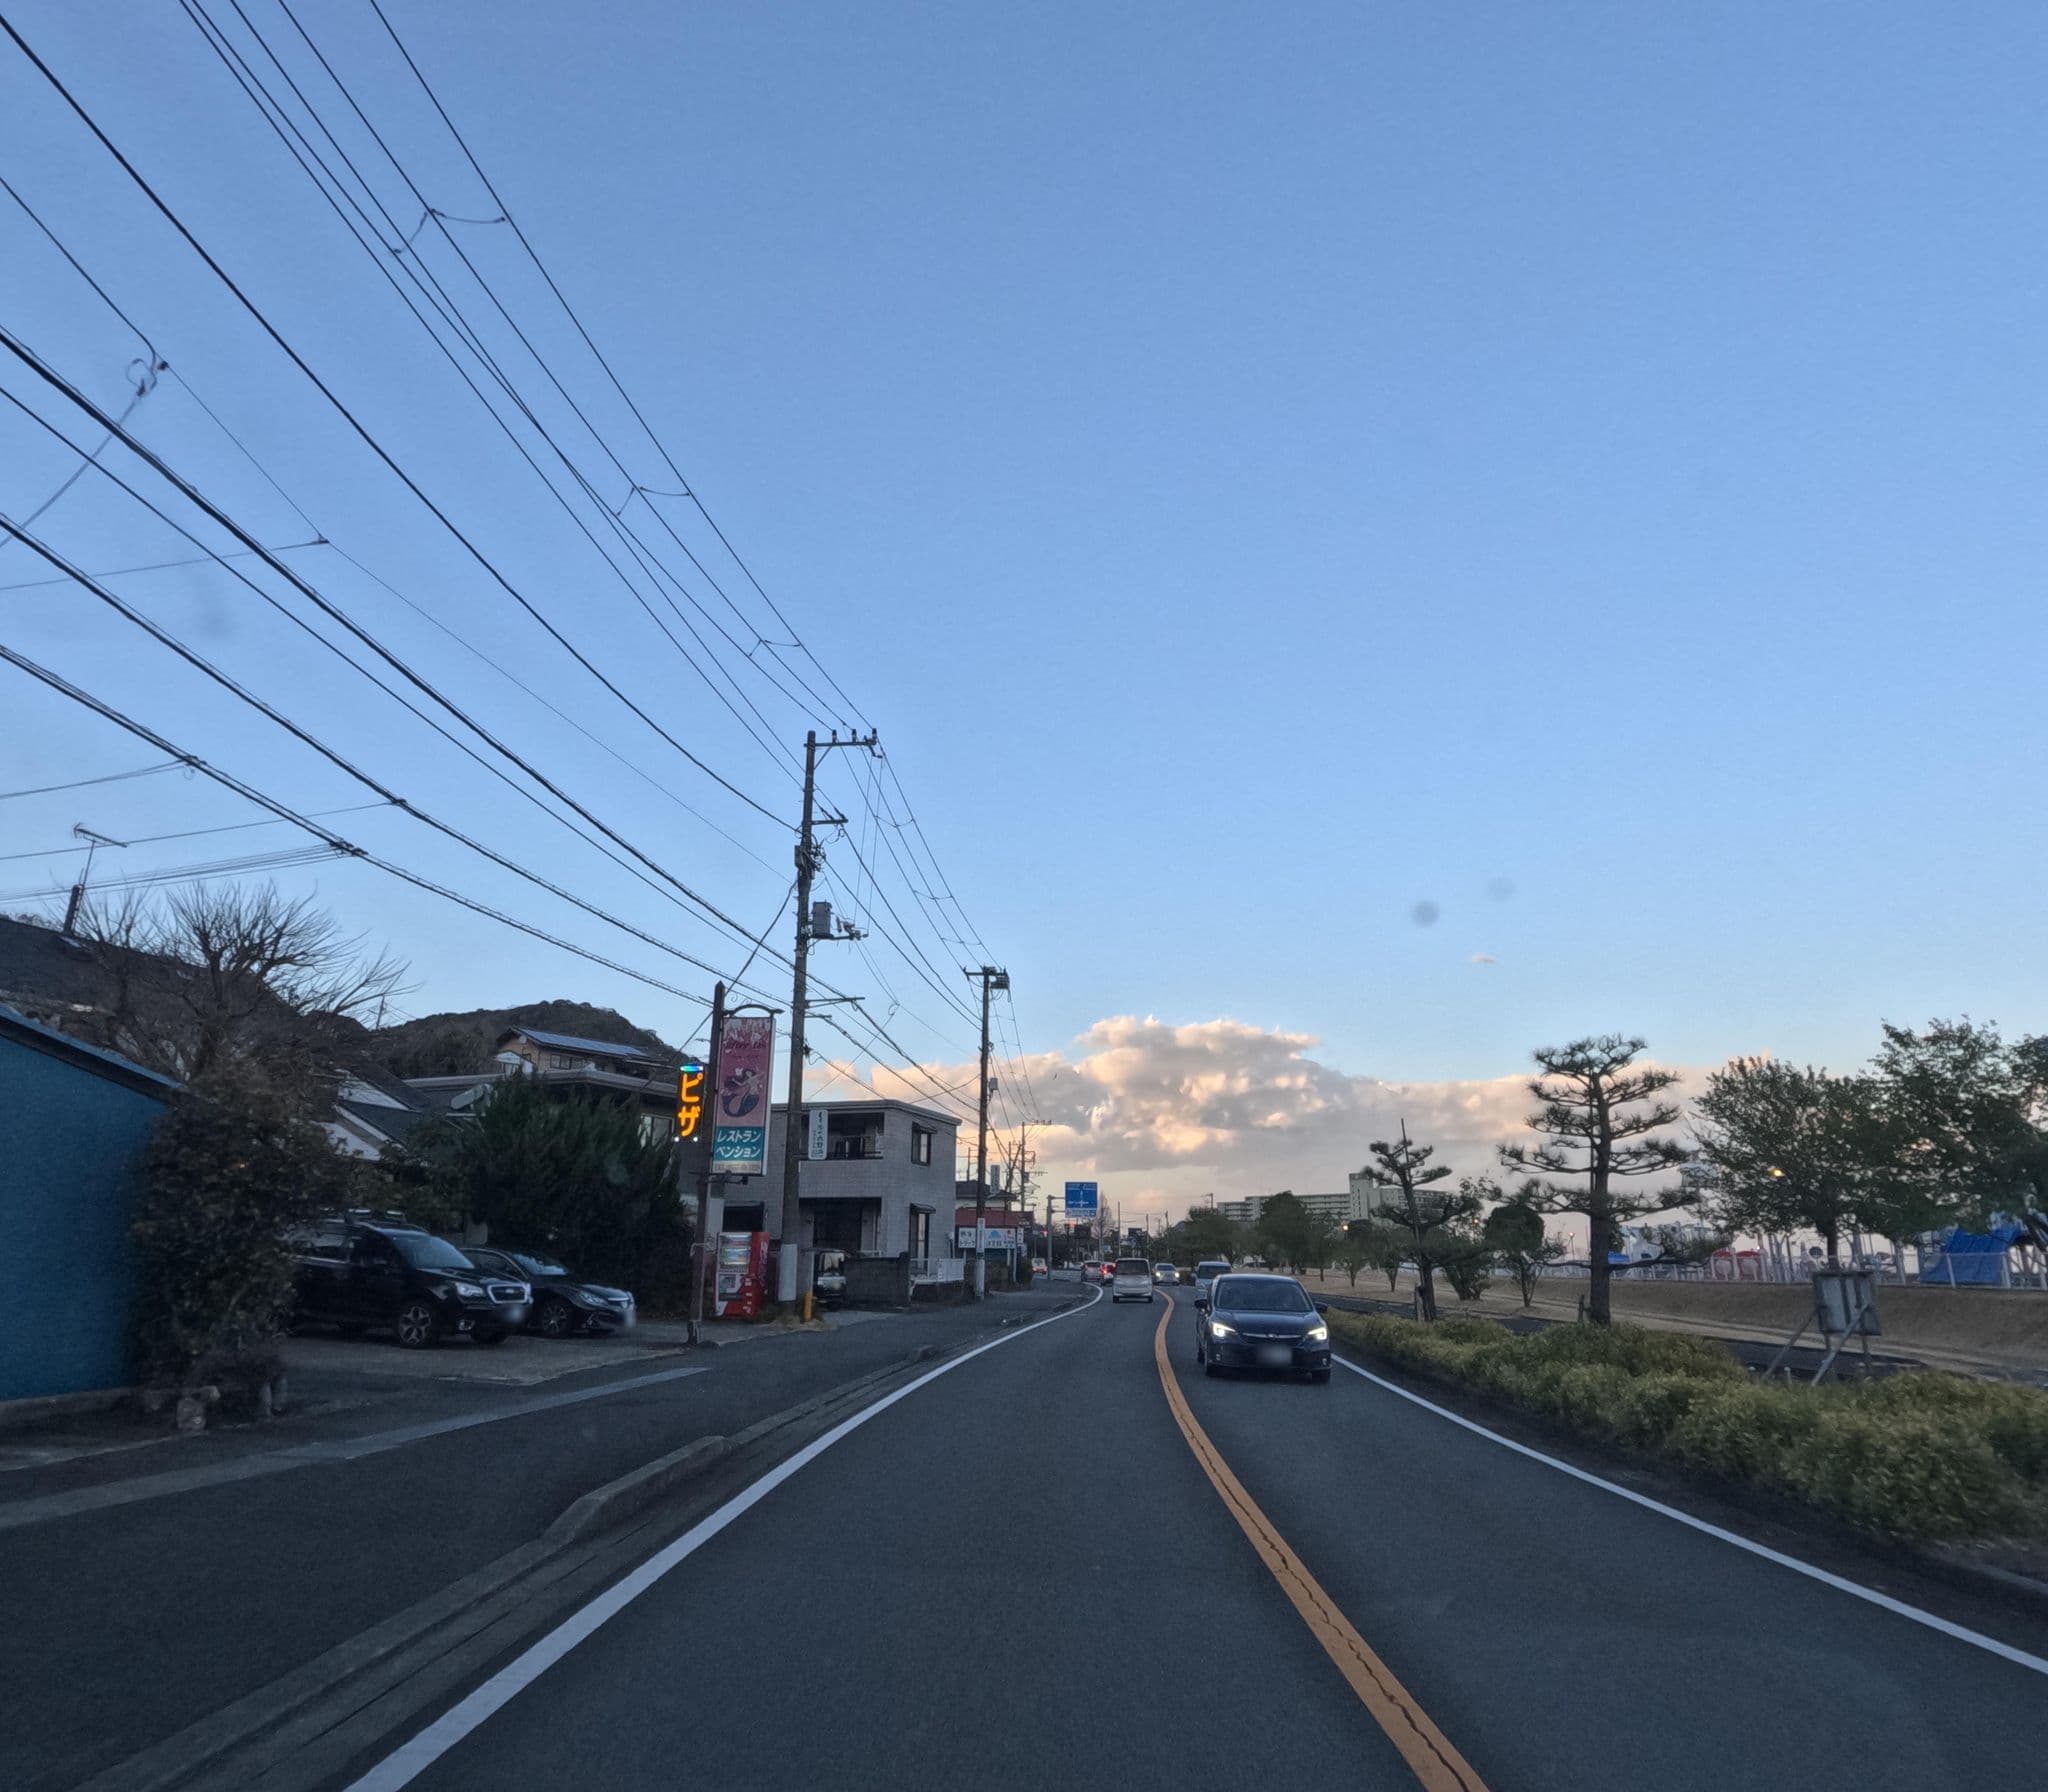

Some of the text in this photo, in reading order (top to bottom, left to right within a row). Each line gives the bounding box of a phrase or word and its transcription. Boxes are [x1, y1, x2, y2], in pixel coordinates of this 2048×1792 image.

[677, 1073, 704, 1137] ピザ
[717, 1129, 762, 1143] レストラン
[715, 1145, 761, 1158] ペンション
